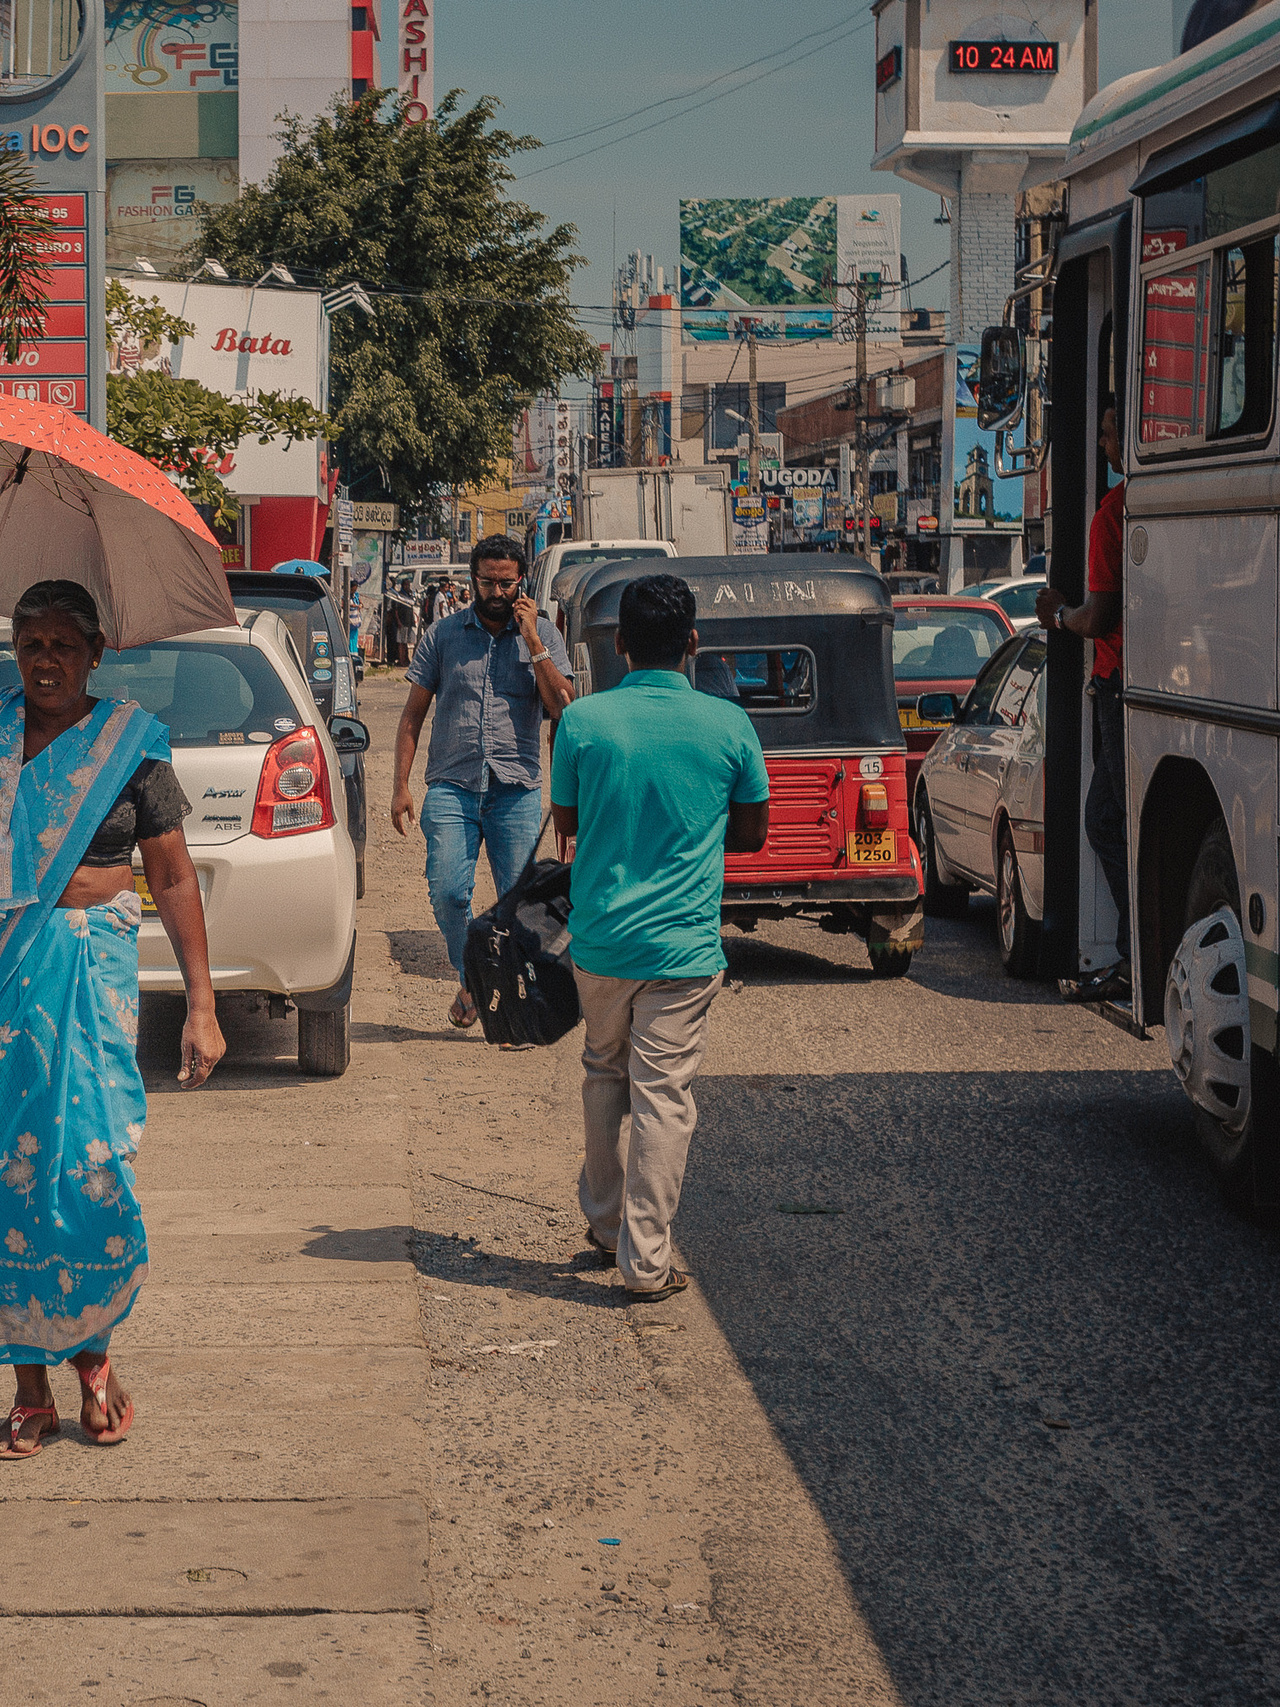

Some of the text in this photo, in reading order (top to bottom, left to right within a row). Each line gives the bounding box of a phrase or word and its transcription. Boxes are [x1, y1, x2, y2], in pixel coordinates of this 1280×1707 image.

[403, 0, 429, 125] ASHIO
[956, 46, 1053, 69] 10 24 AM
[32, 124, 90, 152] IOC
[52, 208, 68, 218] 95
[117, 206, 173, 217] FASHION
[74, 242, 82, 253] 3
[211, 328, 293, 356] Bata
[221, 548, 241, 563] REE
[864, 761, 880, 773] 15
[854, 850, 891, 861] 1250
